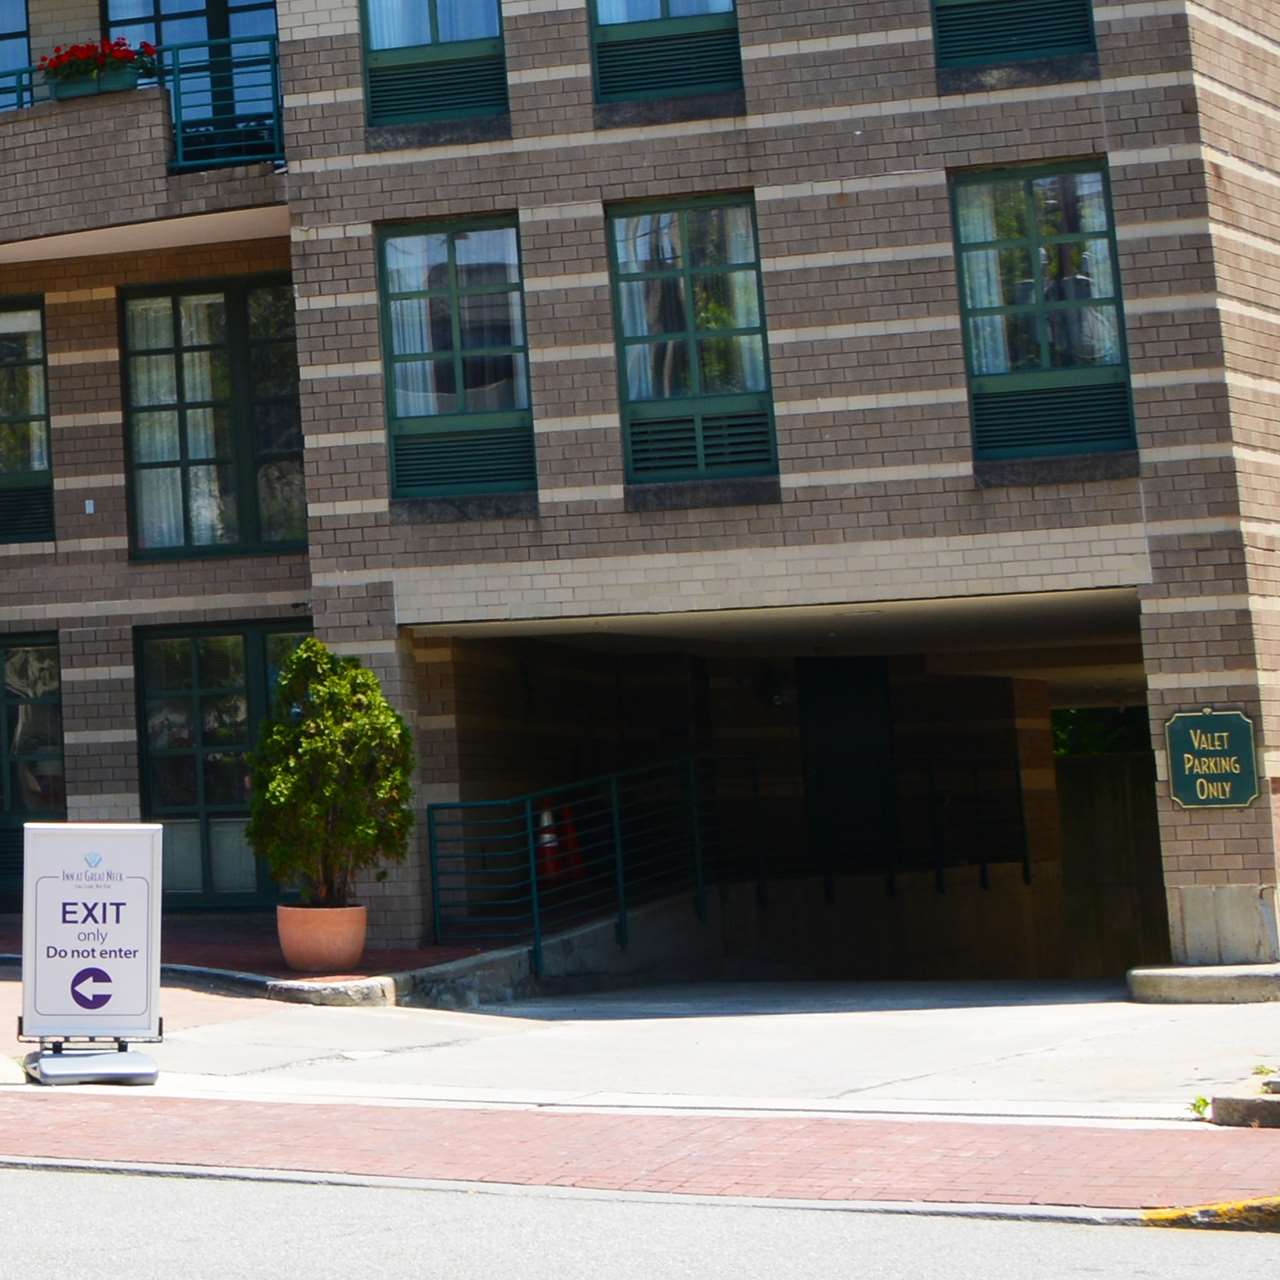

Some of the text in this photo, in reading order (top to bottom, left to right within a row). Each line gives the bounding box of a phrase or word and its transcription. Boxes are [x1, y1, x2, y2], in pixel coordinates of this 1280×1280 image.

[1189, 729, 1229, 750] VALET
[1183, 753, 1241, 775] PARKING
[1196, 778, 1231, 800] ONLY
[62, 902, 127, 924] EXIT
[78, 928, 108, 945] only
[46, 945, 139, 959] Do not enter
